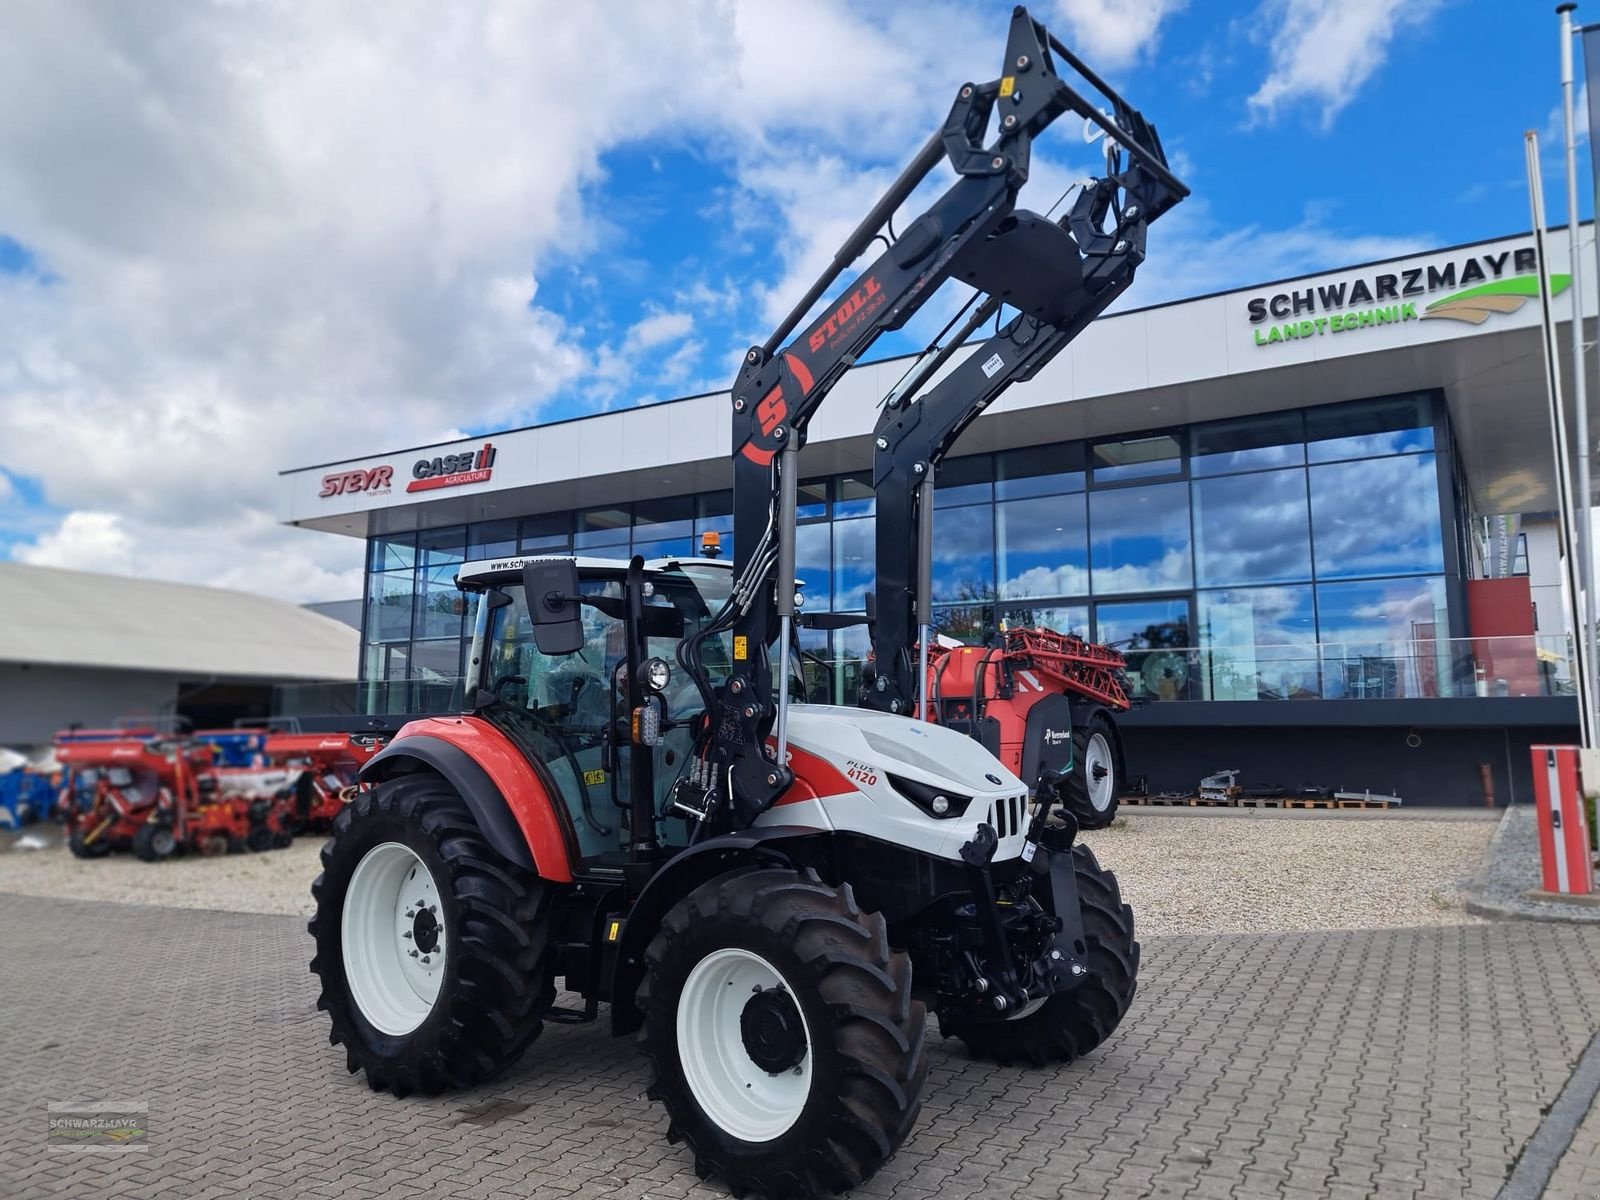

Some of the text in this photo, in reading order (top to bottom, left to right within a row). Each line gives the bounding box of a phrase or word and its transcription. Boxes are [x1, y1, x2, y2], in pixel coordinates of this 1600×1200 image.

[1248, 247, 1538, 323] SCHWARZMAYR
[808, 276, 881, 354] STOLL
[1254, 302, 1418, 346] LANDTECHNIK
[412, 451, 475, 479] CASE
[444, 471, 488, 485] AGRICULTURE
[319, 465, 394, 498] STEYR
[846, 760, 876, 773] PLUS
[847, 768, 877, 786] 4120
